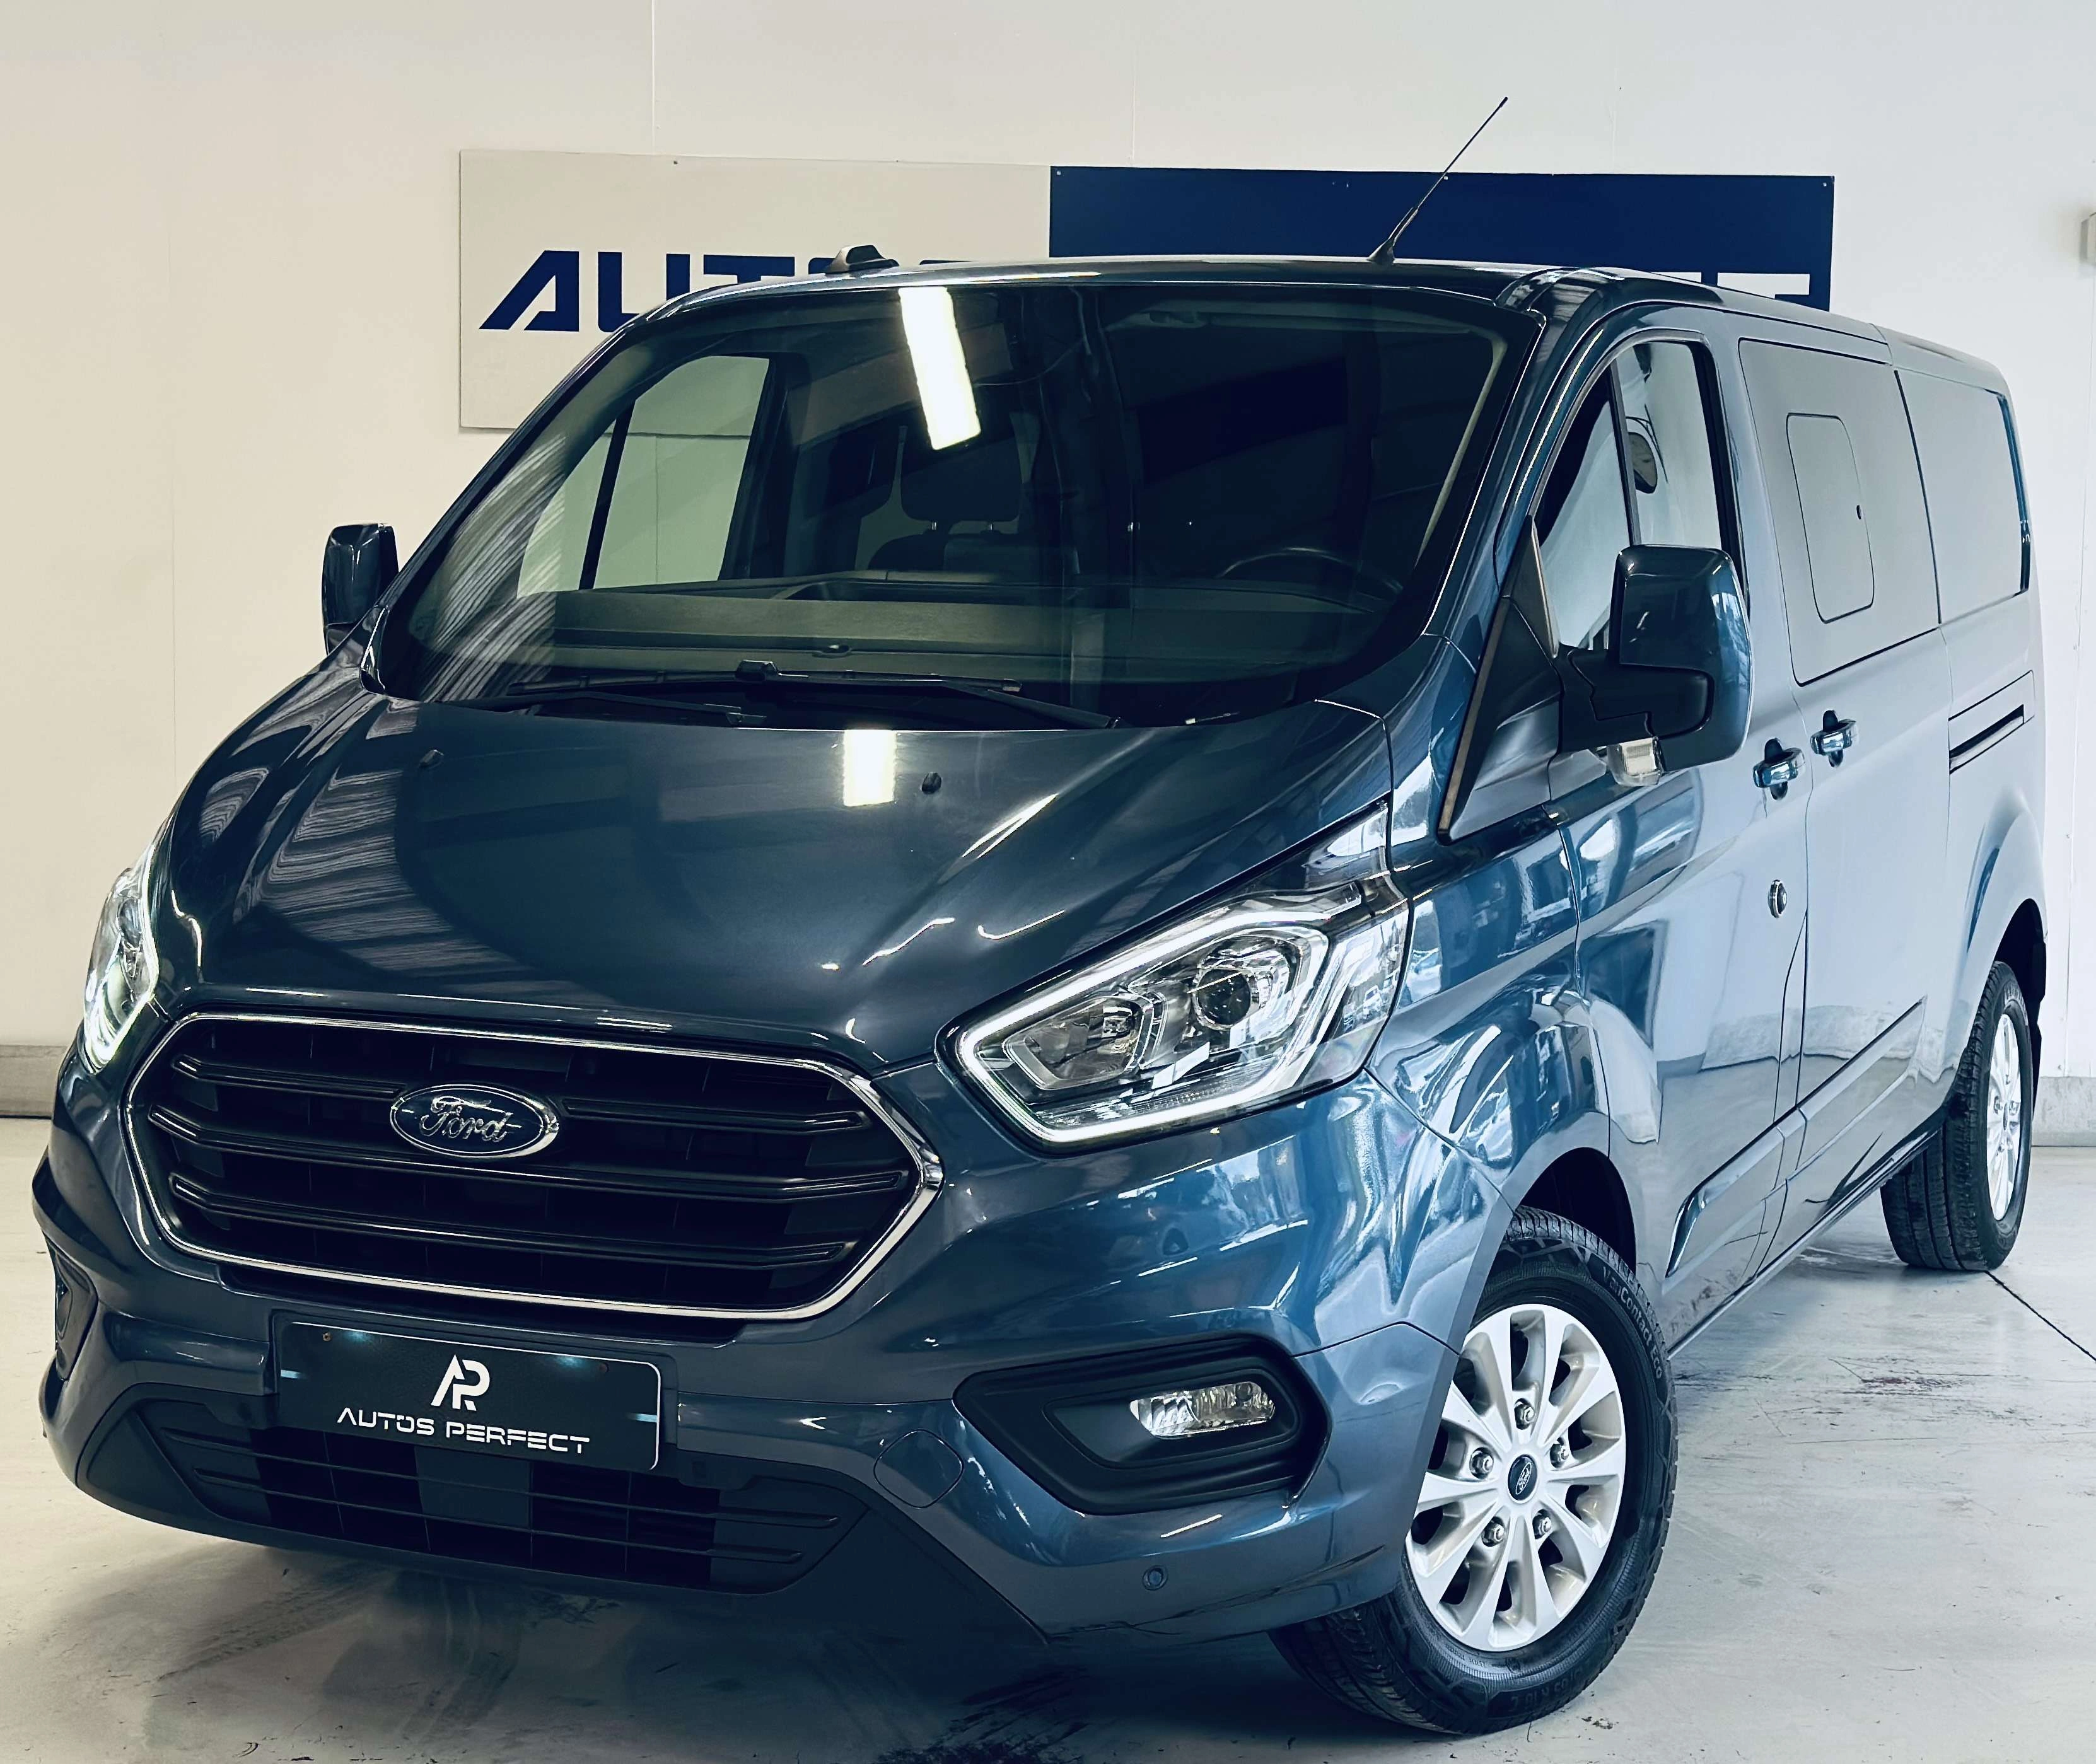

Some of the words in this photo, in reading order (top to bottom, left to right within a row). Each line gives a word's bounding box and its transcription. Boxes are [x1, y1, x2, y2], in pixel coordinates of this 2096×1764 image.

[421, 1096, 522, 1142] Ford
[1650, 1344, 1662, 1379] Eco
[337, 1408, 434, 1436] AUTOS
[446, 1422, 590, 1453] PERFECT
